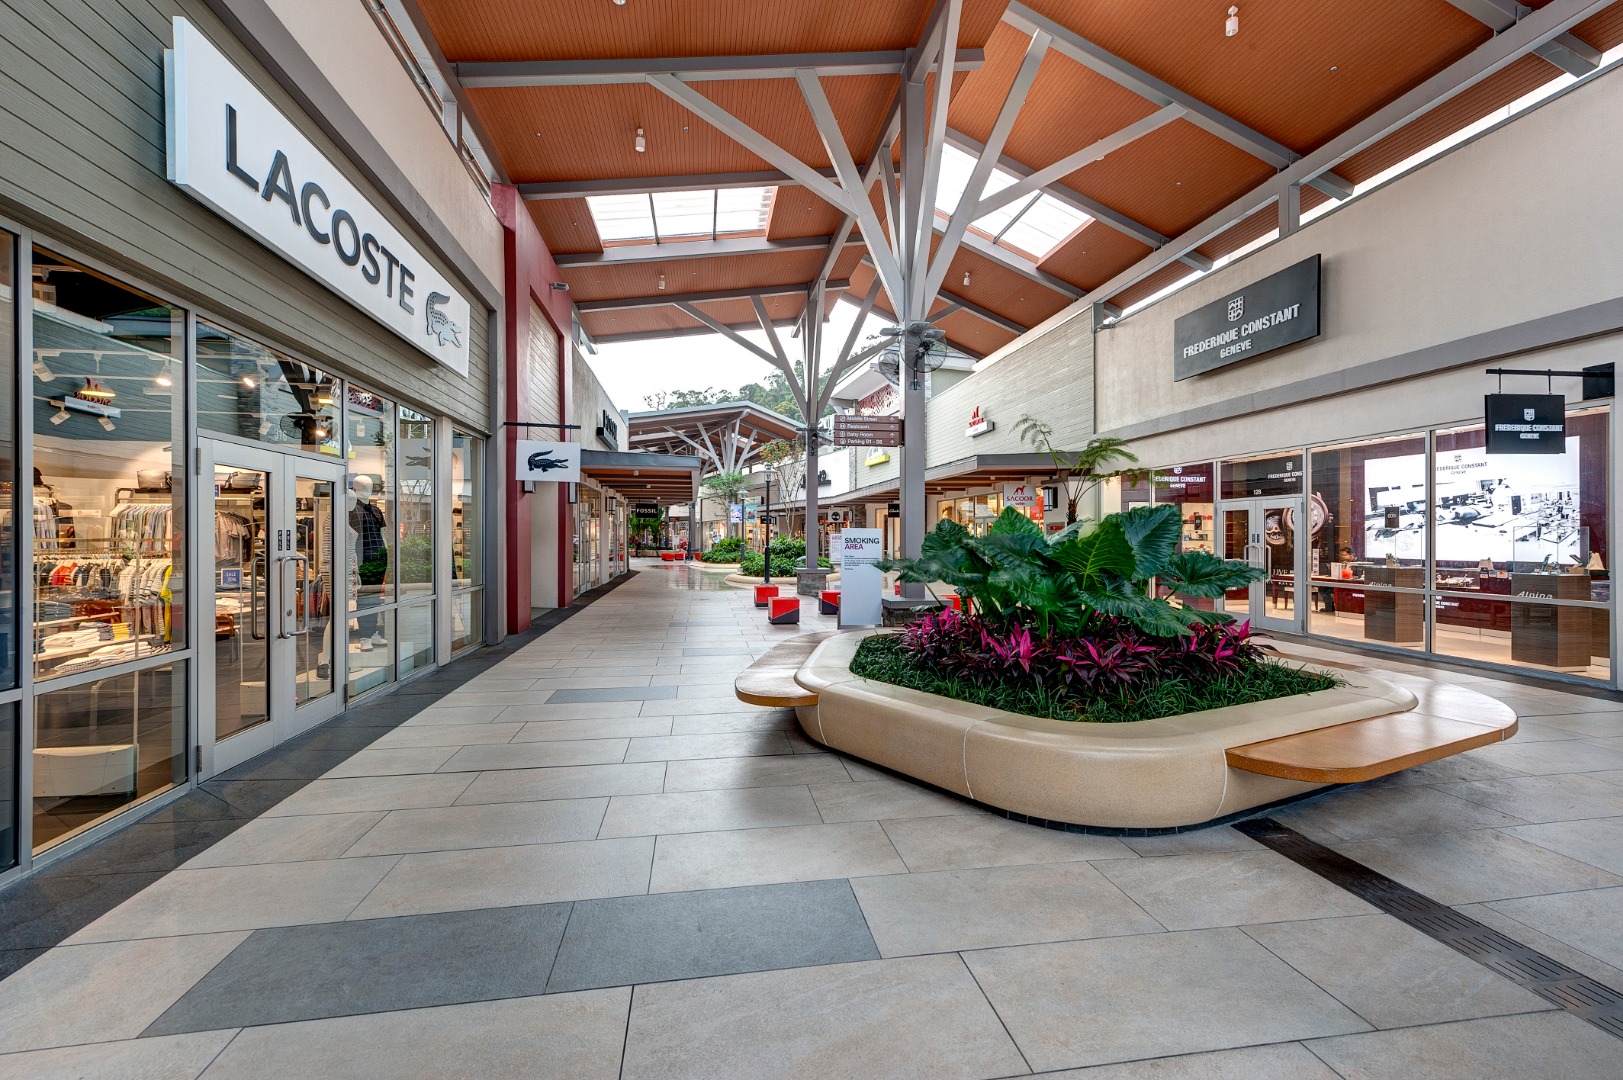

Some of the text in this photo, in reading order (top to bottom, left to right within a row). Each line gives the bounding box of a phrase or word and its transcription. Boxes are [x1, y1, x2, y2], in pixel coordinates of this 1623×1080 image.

[225, 103, 415, 315] LACOSTE
[1183, 303, 1300, 358] FREDERIQUE CONSTANT
[1220, 339, 1252, 358] GENEVE
[274, 428, 288, 440] 316
[1494, 423, 1564, 432] FREDERIQUE CONSTANT
